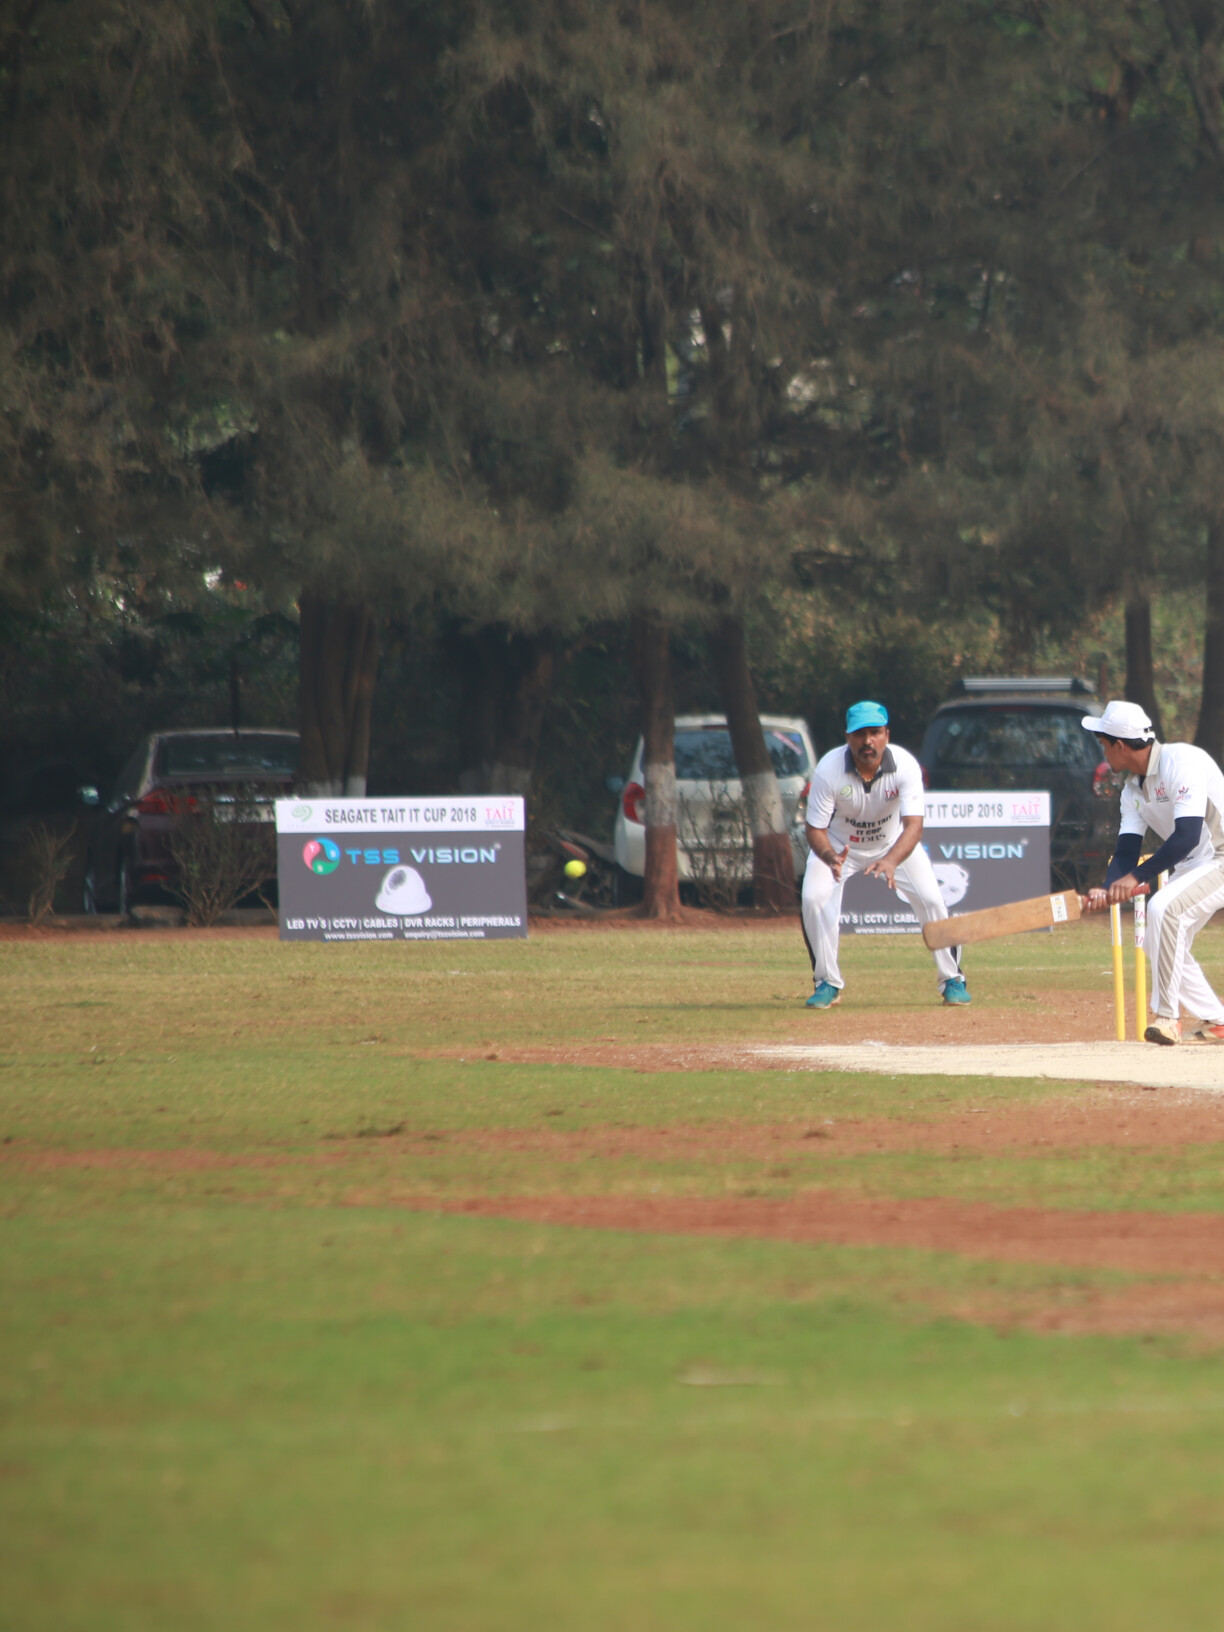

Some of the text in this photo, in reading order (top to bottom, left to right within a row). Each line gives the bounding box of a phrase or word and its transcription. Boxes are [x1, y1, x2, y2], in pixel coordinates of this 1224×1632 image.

[325, 809, 378, 823] SEAGATE
[381, 809, 406, 823] TAIT
[409, 808, 420, 822] IT
[424, 808, 447, 823] CUP
[450, 807, 477, 823] 2018
[937, 804, 948, 818] IT
[952, 804, 974, 818] CUP
[977, 803, 1003, 818] 2018
[345, 848, 496, 865] TSS VISION
[940, 844, 1023, 859] VISION
[286, 919, 304, 929] LED
[333, 919, 357, 929] CCTV
[363, 919, 398, 928] CABLES
[405, 918, 423, 927] DVR
[425, 917, 454, 927] RACKS
[461, 917, 520, 927] PERIPHERALS
[864, 914, 888, 924] CCTV
[894, 913, 920, 924] CABL
